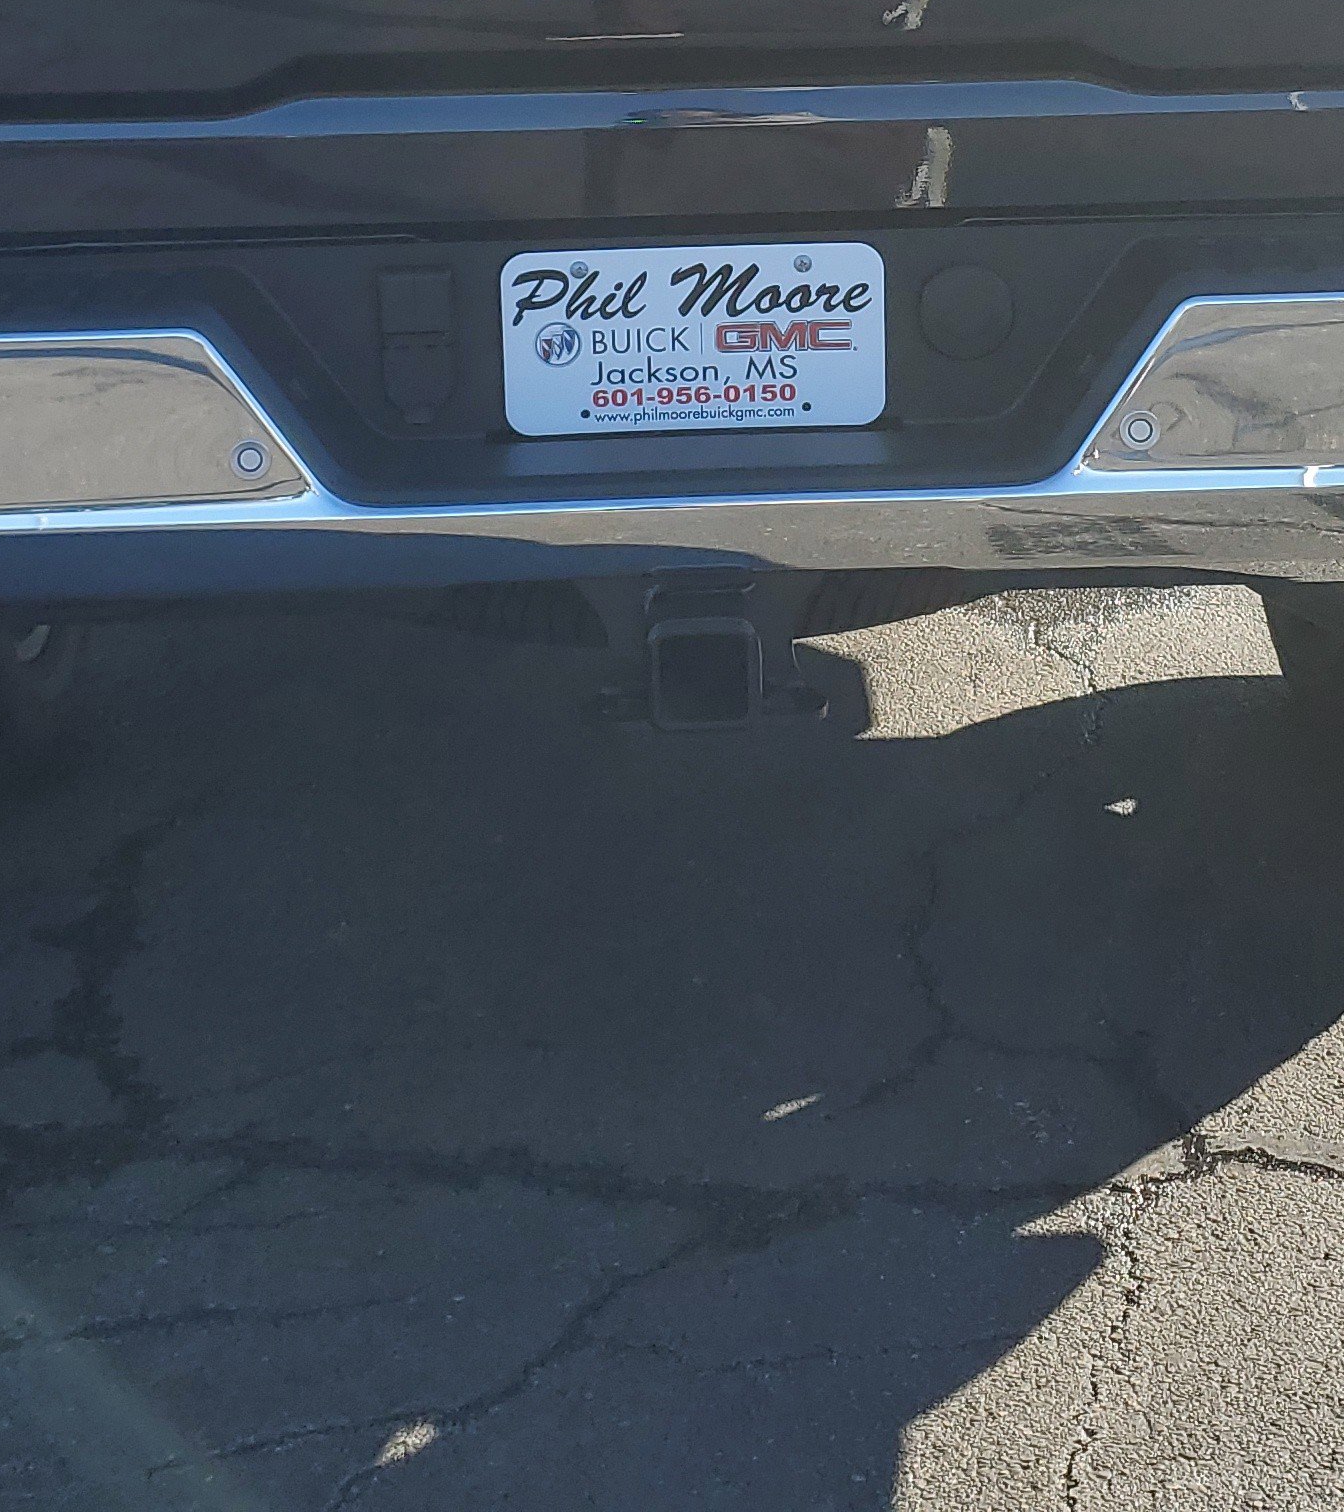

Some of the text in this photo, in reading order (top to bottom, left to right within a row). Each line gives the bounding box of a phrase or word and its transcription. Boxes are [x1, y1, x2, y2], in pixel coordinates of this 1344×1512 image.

[511, 261, 873, 327] Phil Moore
[591, 318, 854, 355] BUICK GMC
[589, 354, 799, 388] Jackson, MS
[591, 382, 798, 408] 601-956-0150
[593, 404, 796, 426] www.philmoorebuickgmc.com
